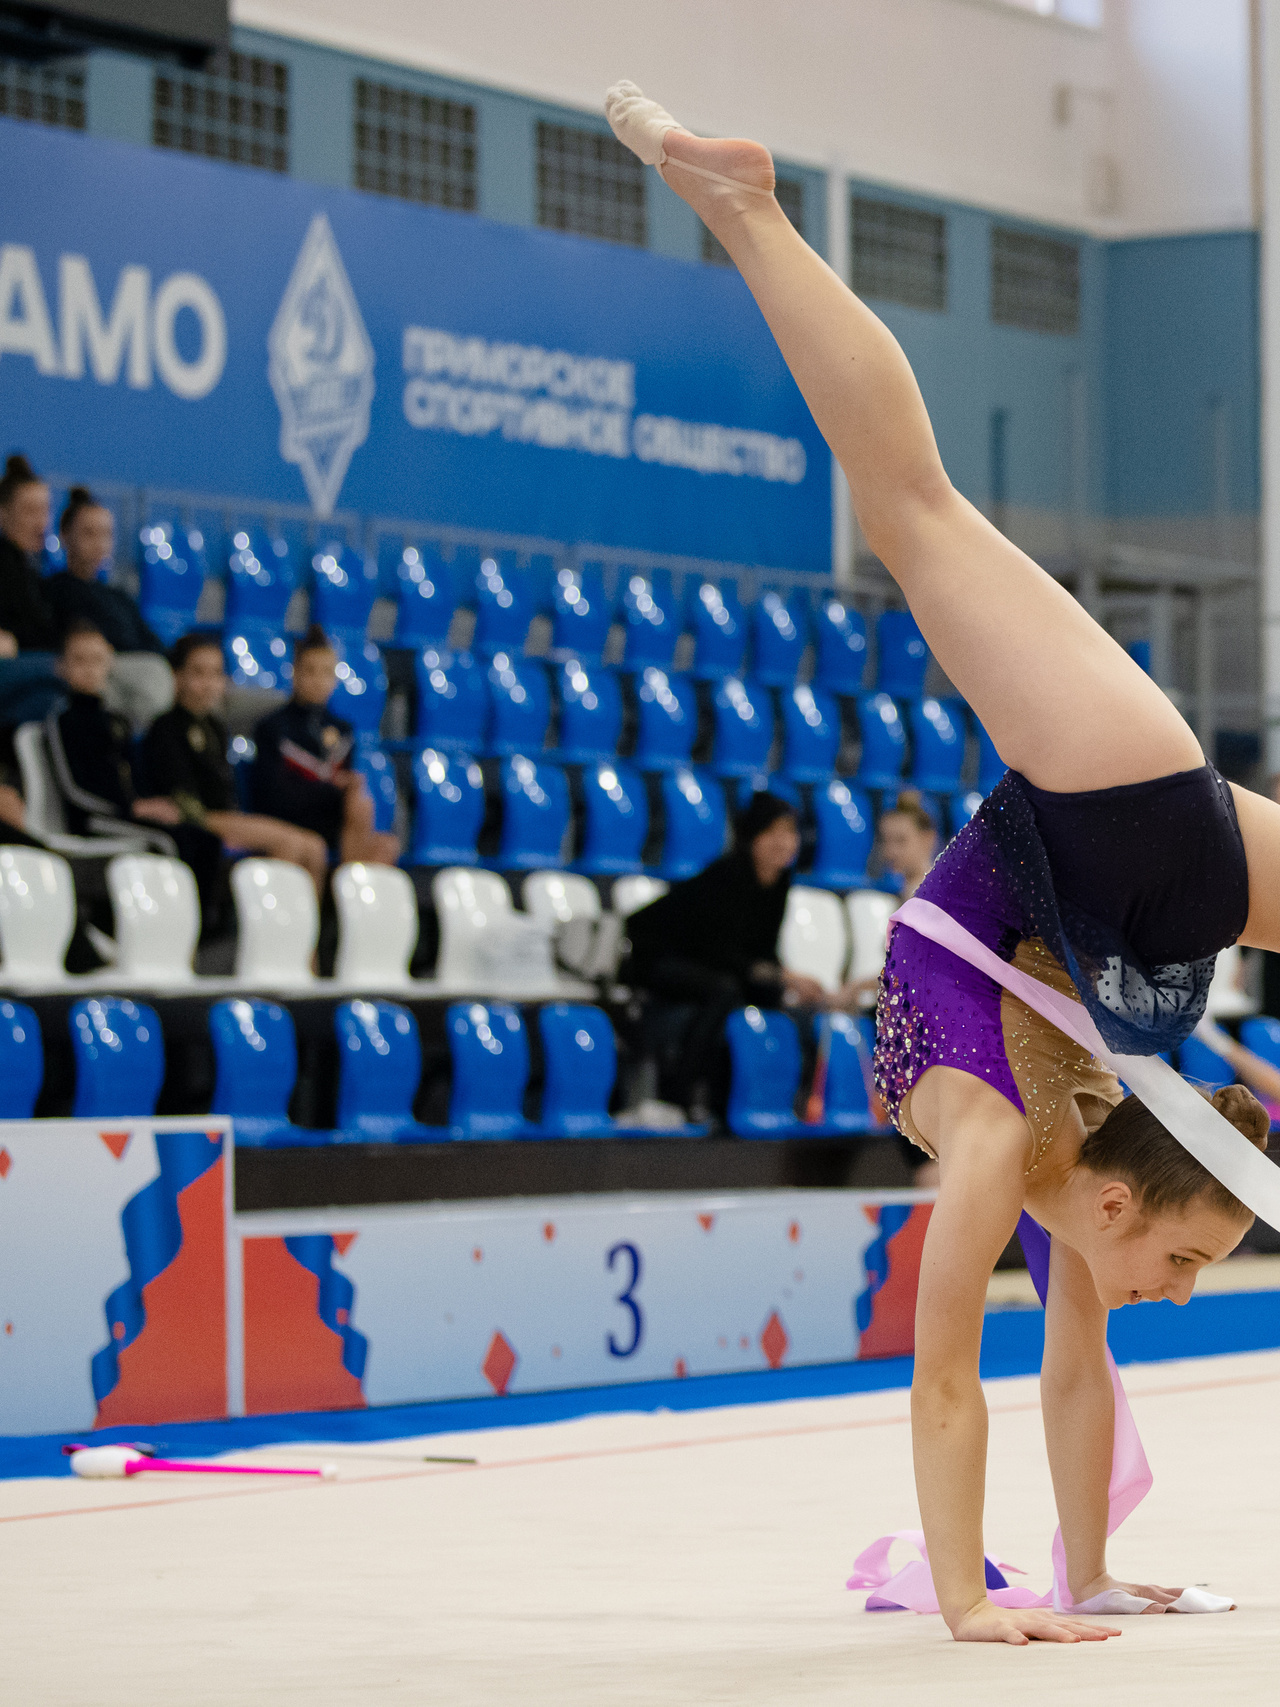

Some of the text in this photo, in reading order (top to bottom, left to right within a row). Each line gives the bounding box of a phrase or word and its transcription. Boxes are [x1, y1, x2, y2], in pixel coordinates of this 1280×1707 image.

[0, 244, 227, 399] АМО
[404, 326, 635, 405] ПРИМОРСКОЕ
[404, 380, 633, 458] СПОРТИВНОЕ
[607, 1242, 643, 1357] 3
